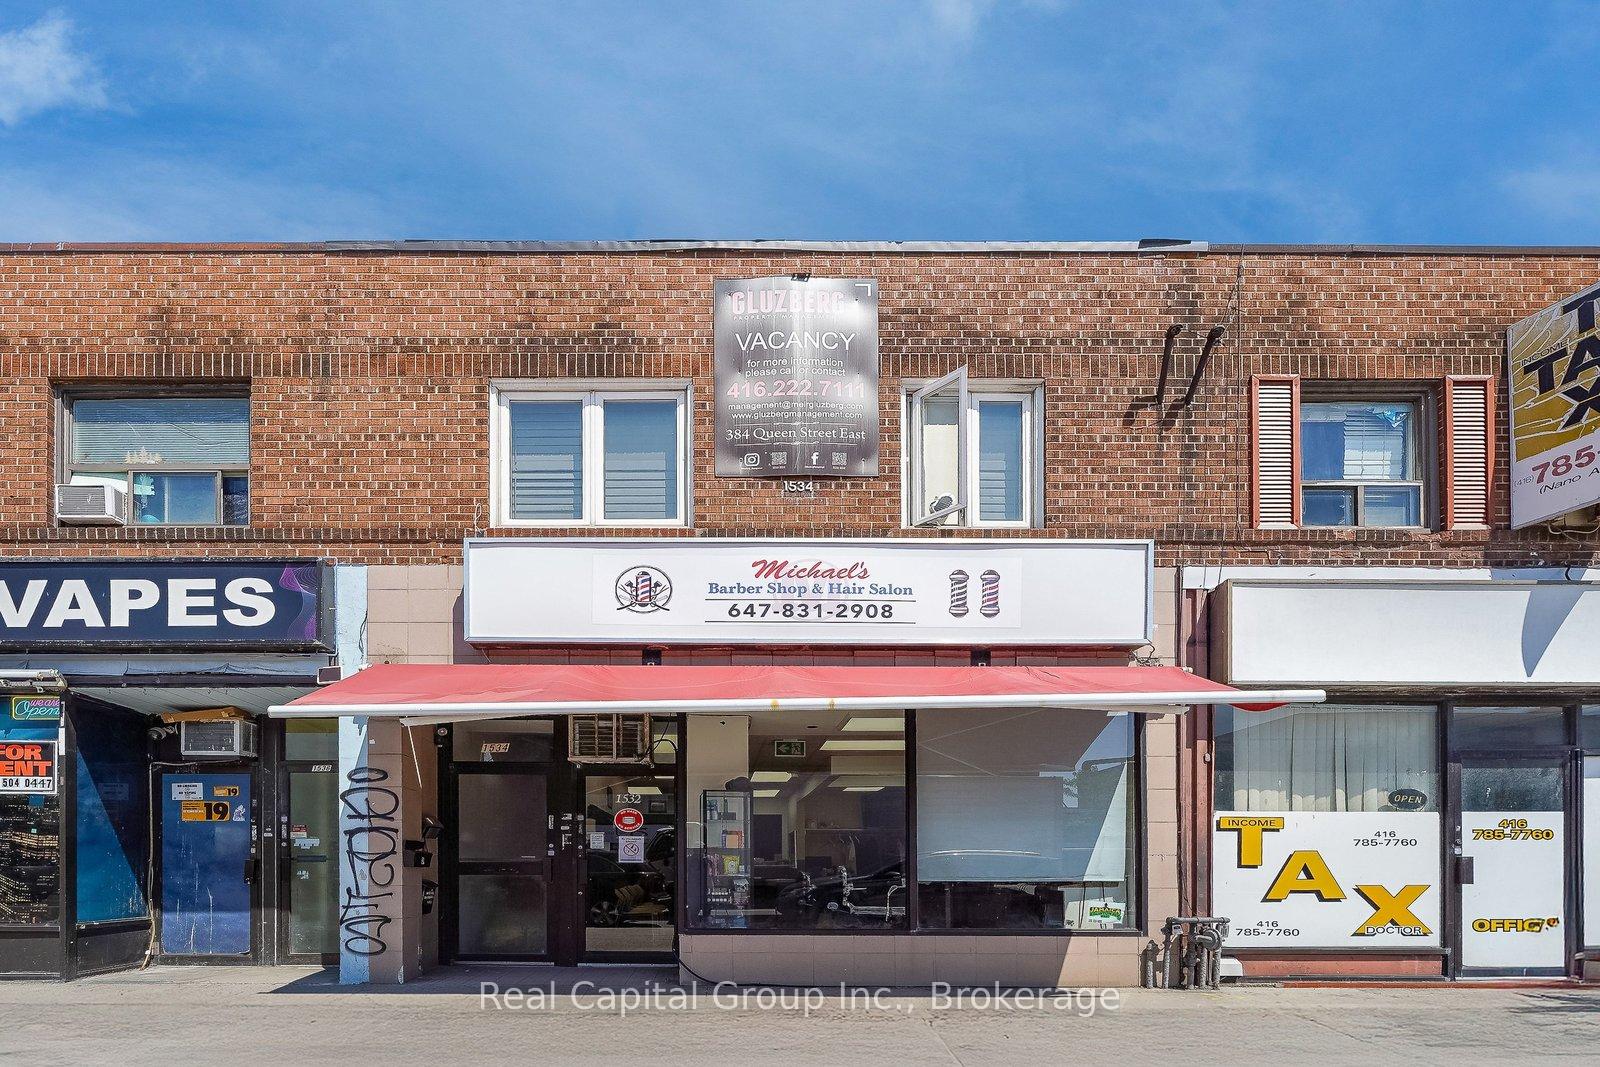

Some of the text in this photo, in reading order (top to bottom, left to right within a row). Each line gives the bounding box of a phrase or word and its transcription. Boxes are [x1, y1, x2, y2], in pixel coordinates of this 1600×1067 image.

[732, 290, 845, 314] GLUZBERG
[735, 332, 856, 351] VACANCY
[1521, 340, 1568, 367] INCOME
[747, 357, 843, 368] for more information
[745, 367, 846, 378] please call or contact
[727, 380, 865, 398] 416.222.7111
[731, 411, 863, 420] www.gluzbergmanagement.com
[725, 427, 866, 440] 384 Queen Street East
[1532, 444, 1600, 484] 785
[784, 480, 813, 492] 1534
[1539, 474, 1581, 494] (Nano
[752, 559, 870, 580] Michael's
[708, 583, 914, 597] Barber Shop & Hair Salon
[0, 577, 276, 628] VAPES
[727, 603, 894, 618] 647-831-2908
[15, 700, 60, 720] Open
[3, 778, 52, 788] 504 0447
[227, 788, 238, 796] 19
[615, 793, 642, 804] 1532
[1394, 794, 1423, 804] OPEN
[204, 802, 229, 821] 19
[1228, 819, 1276, 827] INCOME
[1498, 819, 1528, 829] 416
[1472, 829, 1554, 840] 785-7760
[1353, 838, 1418, 847] 785-7760
[1256, 920, 1279, 928] 416
[1235, 928, 1300, 937] 785-7760
[1365, 926, 1423, 935] DOCTOR
